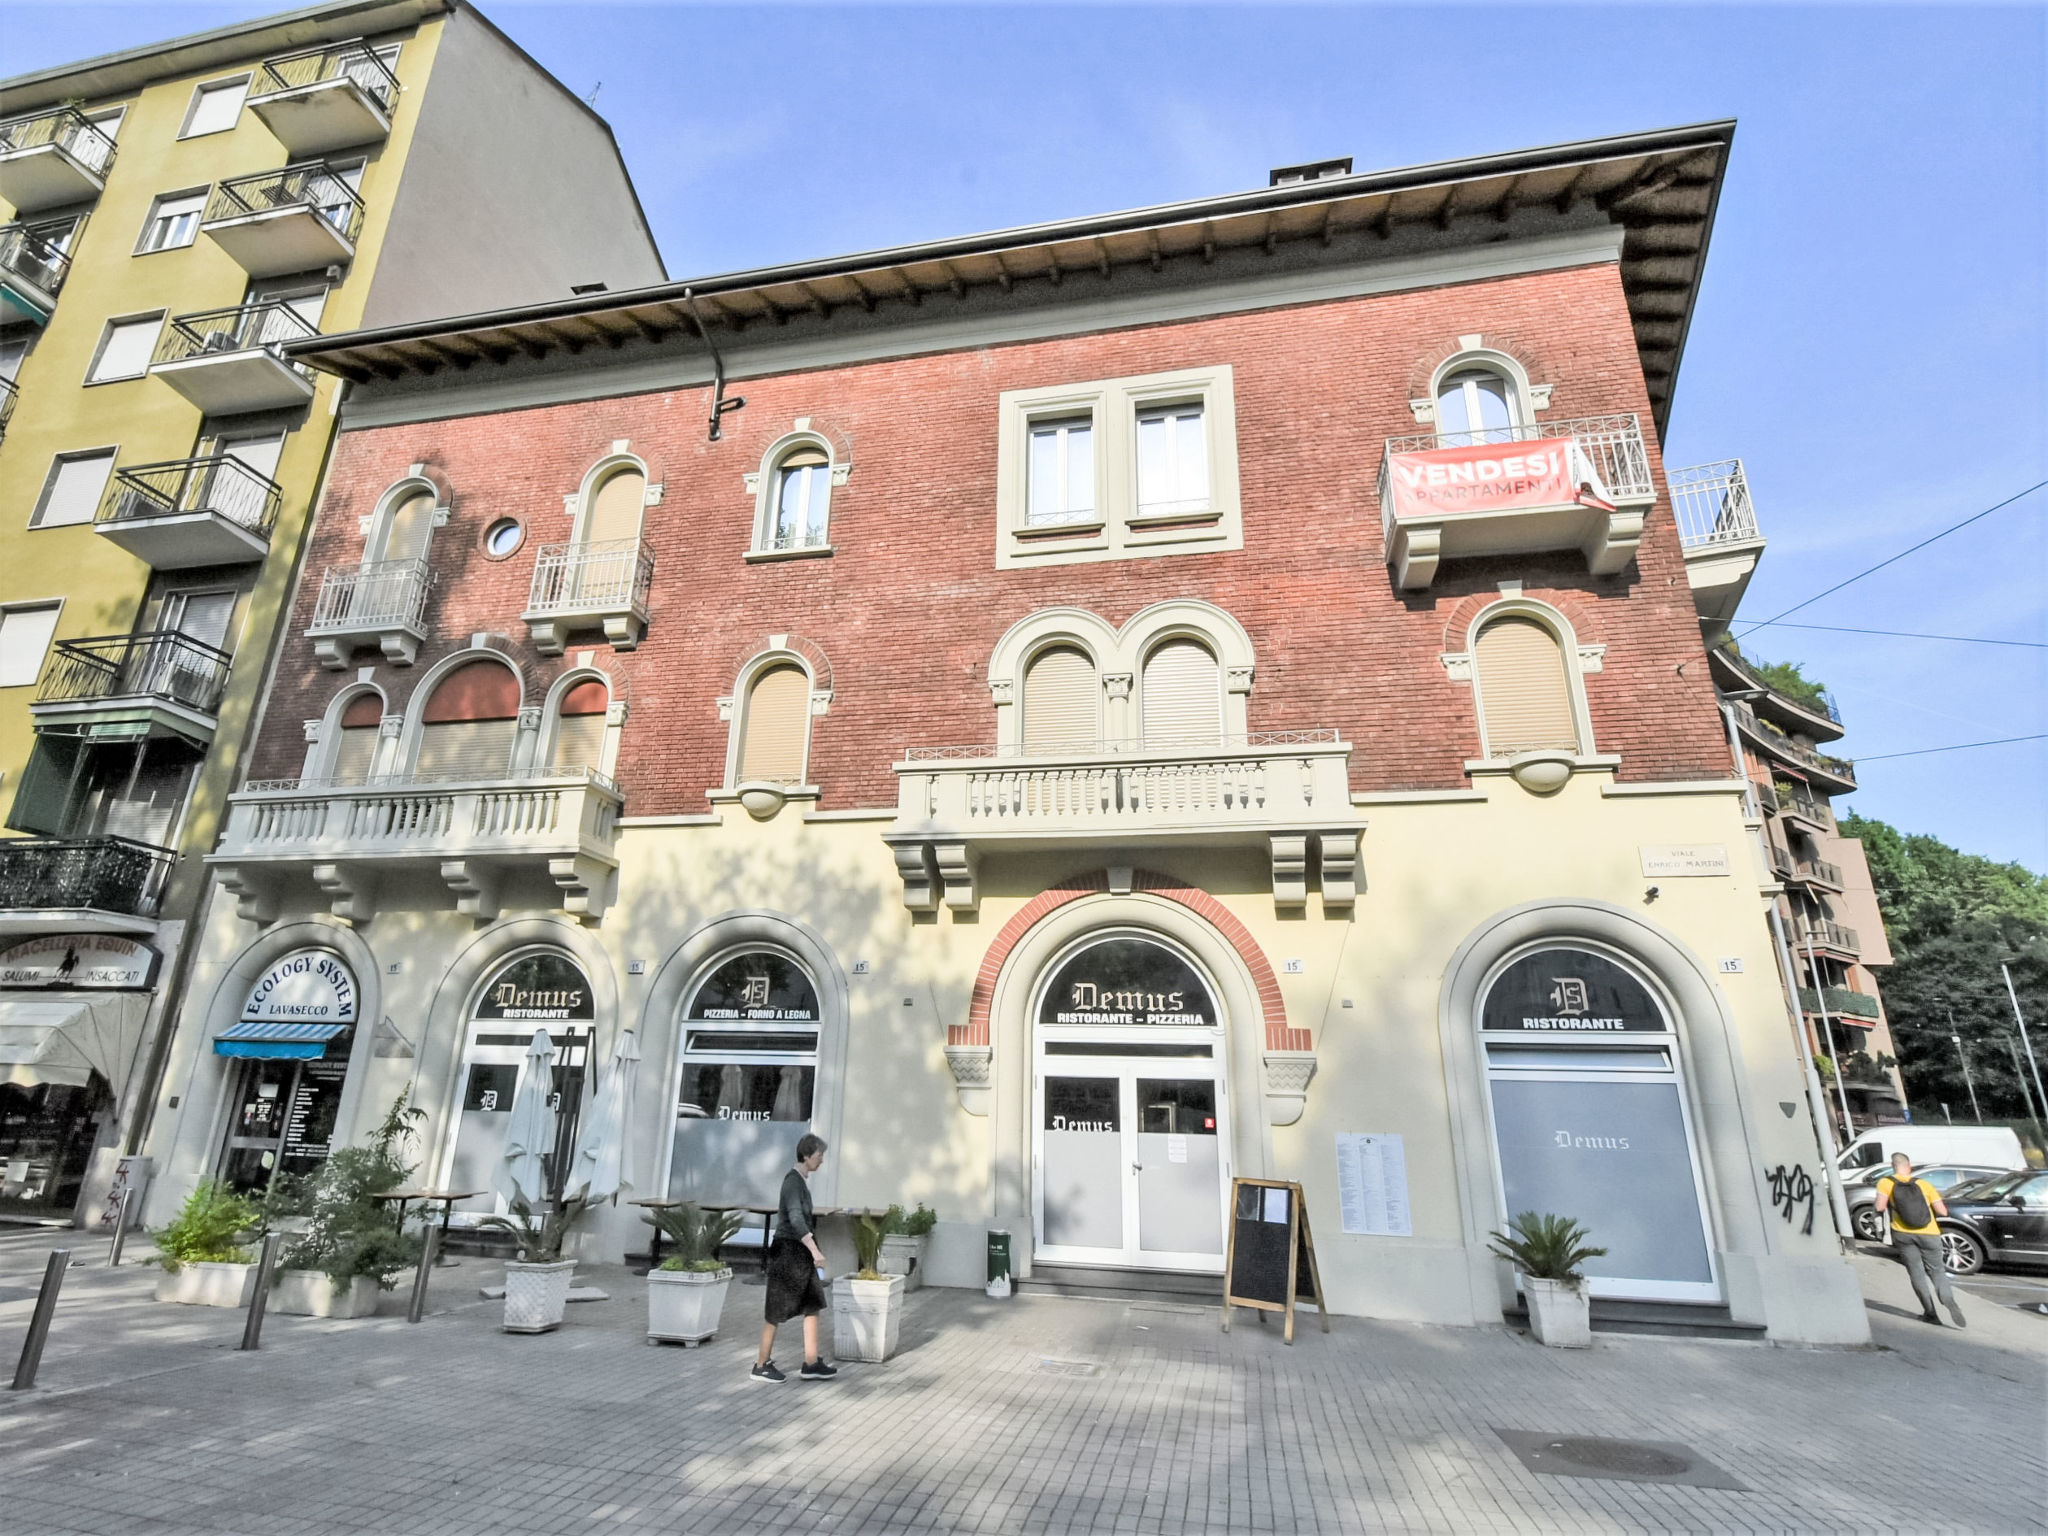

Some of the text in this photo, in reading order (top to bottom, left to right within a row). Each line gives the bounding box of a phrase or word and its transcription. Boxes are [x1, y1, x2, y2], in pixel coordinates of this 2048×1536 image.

[1399, 452, 1559, 487] VENDESI
[1685, 860, 1724, 868] MARTINI
[6, 935, 91, 963] MACELLERIA
[855, 963, 865, 971] 15
[1287, 962, 1298, 971] 15
[1725, 961, 1737, 971] 15
[2, 970, 140, 982] SALUMI INSACCATI
[247, 957, 352, 1017] ECOLOGY SYSTEM
[495, 983, 582, 1007] Demus
[1071, 982, 1184, 1012] Demus
[269, 1004, 328, 1016] LAVASECCO
[502, 1008, 570, 1019] RISTORANTE
[703, 1008, 739, 1019] PIZZERIA
[747, 1009, 775, 1019] FORNO
[784, 1010, 811, 1019] LEGNA
[1057, 1012, 1134, 1024] RISTORANTE
[1147, 1014, 1204, 1025] PIZZERIA
[1522, 1017, 1624, 1030] RISTORANTE
[718, 1105, 771, 1121] Demus
[1052, 1115, 1113, 1132] Demus
[1554, 1130, 1630, 1150] Demus
